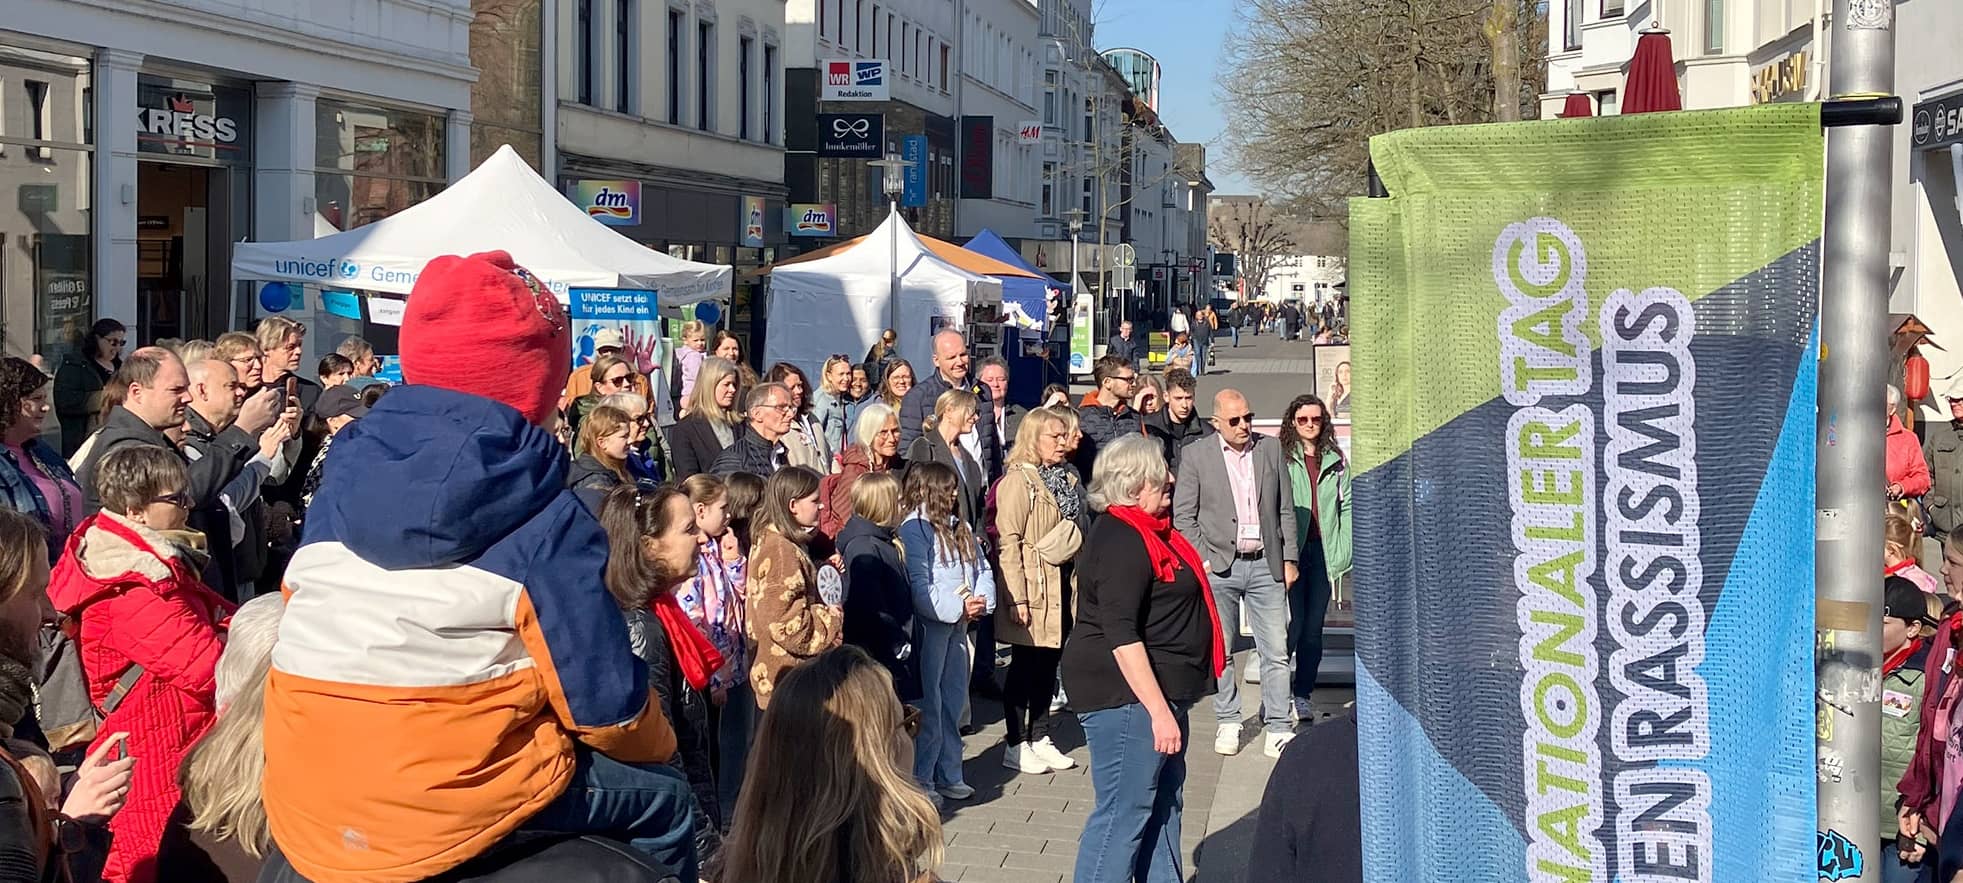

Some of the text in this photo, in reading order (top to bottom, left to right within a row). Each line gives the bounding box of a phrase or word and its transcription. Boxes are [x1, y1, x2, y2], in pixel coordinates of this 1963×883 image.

[830, 68, 881, 85] WR WP
[837, 90, 872, 98] Redaktion
[1020, 126, 1040, 139] H&M
[825, 141, 876, 151] hunkemöller
[595, 187, 626, 207] dm
[803, 209, 826, 223] dm
[275, 256, 337, 278] unicef
[580, 292, 611, 303] UNICEF
[612, 294, 632, 303] setzt
[594, 304, 616, 315] jedes
[616, 304, 635, 314] Kind
[636, 305, 649, 314] ein
[1506, 231, 1579, 392] TAG
[1614, 301, 1700, 881] EN RASSISMUS
